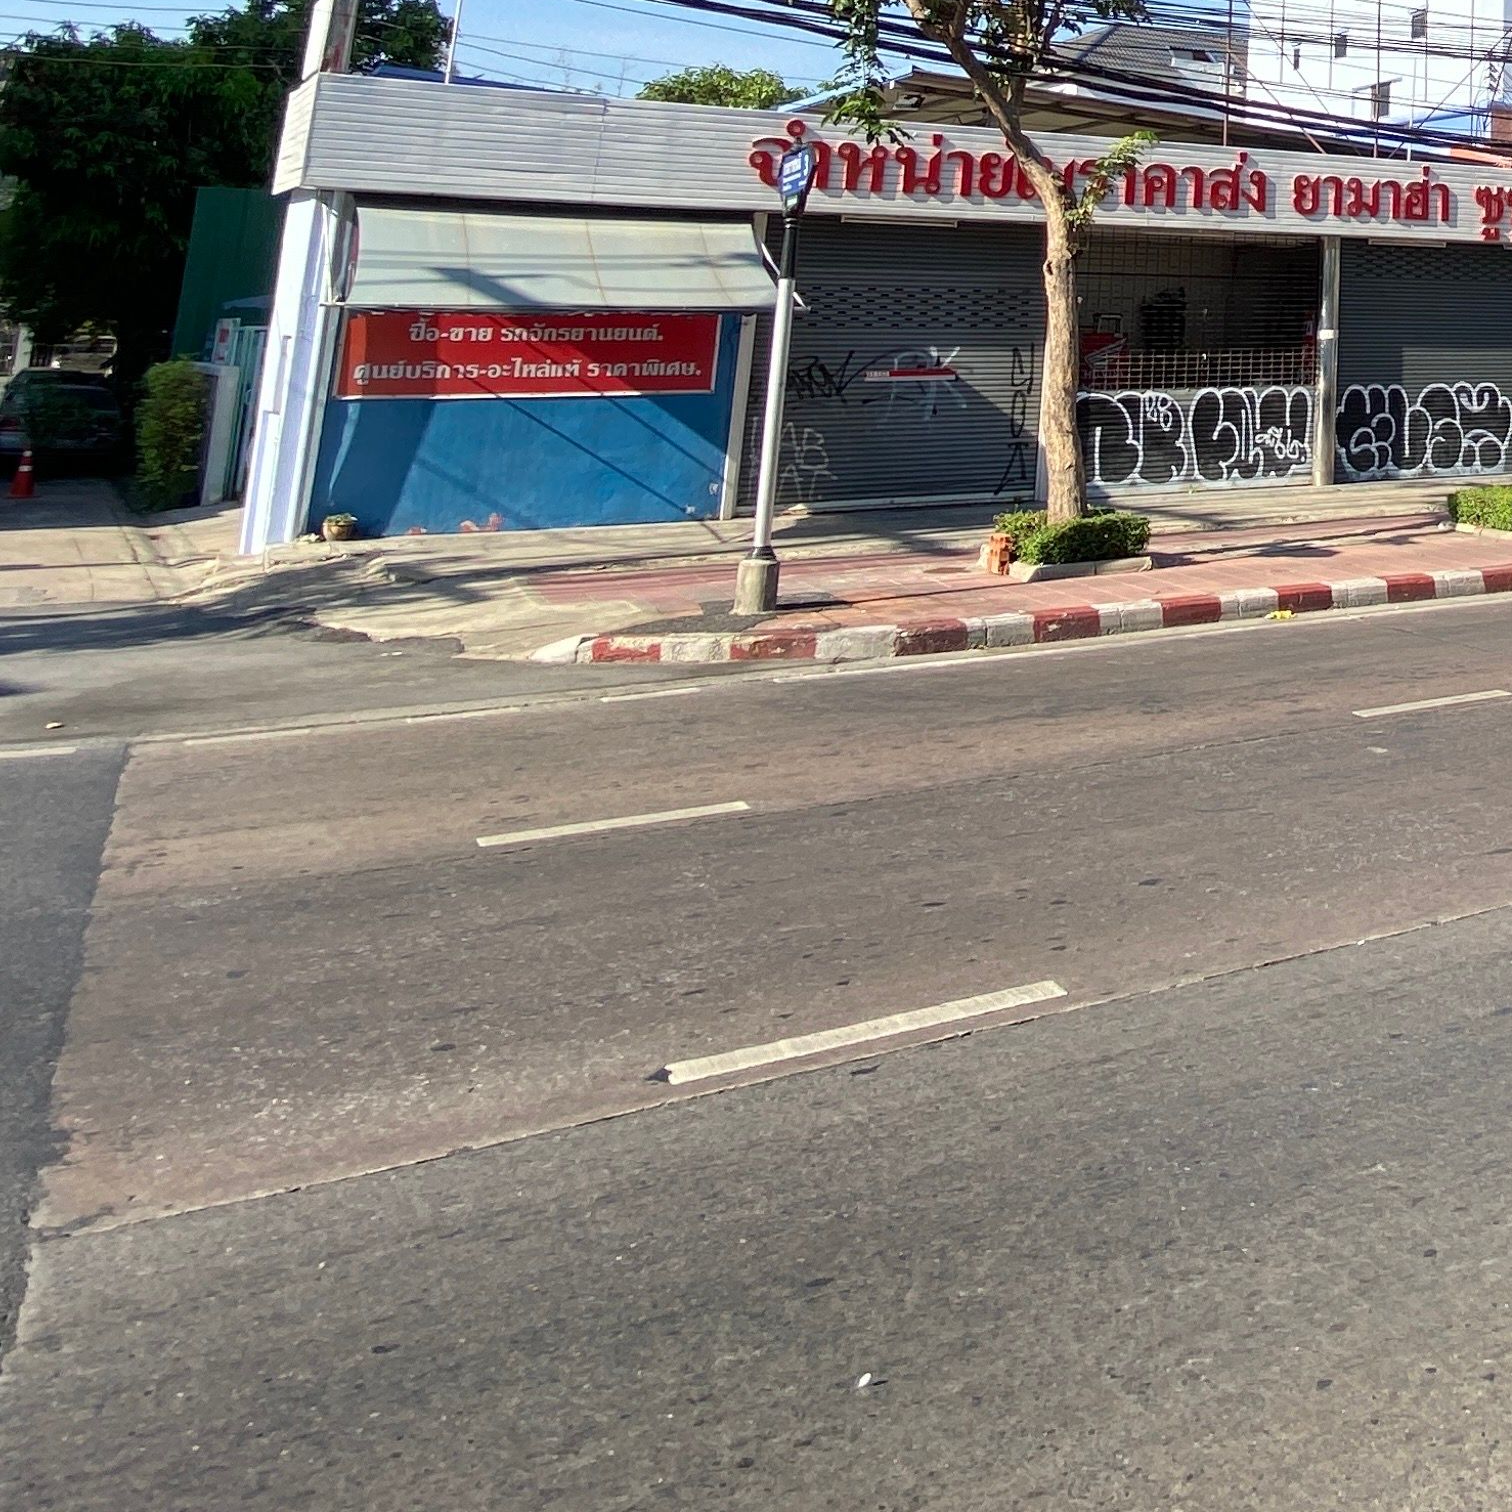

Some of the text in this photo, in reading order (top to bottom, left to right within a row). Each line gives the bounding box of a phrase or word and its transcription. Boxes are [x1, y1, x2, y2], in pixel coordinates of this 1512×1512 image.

[749, 120, 1266, 213] จำหน่ายราคาส่ง
[1294, 165, 1450, 222] ยามาฮ่า
